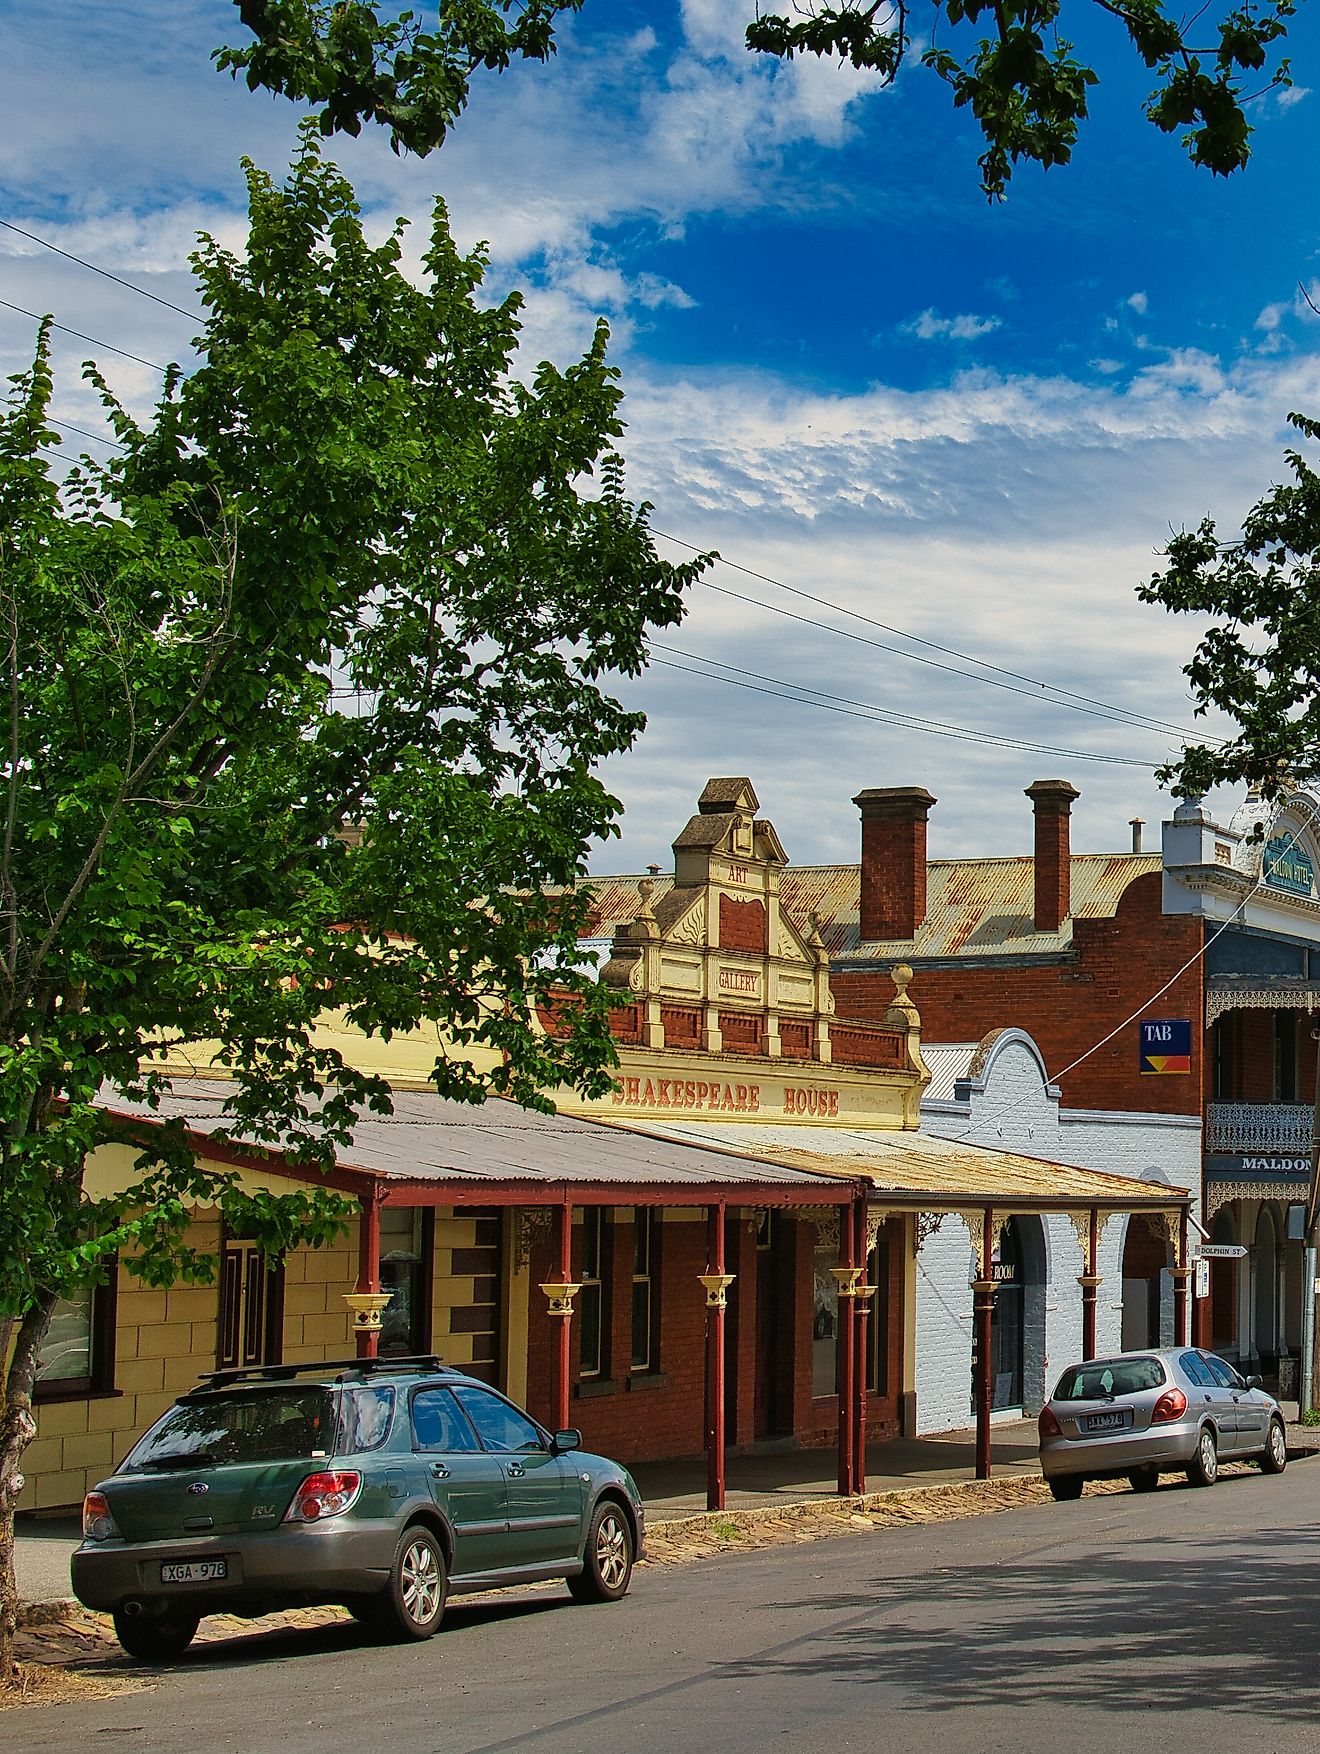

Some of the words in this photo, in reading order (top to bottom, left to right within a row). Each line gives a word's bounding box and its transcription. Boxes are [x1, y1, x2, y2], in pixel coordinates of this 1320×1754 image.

[728, 865, 748, 883] ART
[720, 972, 757, 992] GALLERY
[1144, 1025, 1172, 1041] TAB
[613, 1076, 760, 1112] SHAKESPEARE
[783, 1087, 839, 1117] HOUSE
[1242, 1157, 1311, 1171] MALDON
[1201, 1247, 1230, 1255] DOLPHIN
[994, 1264, 1015, 1280] ROOM
